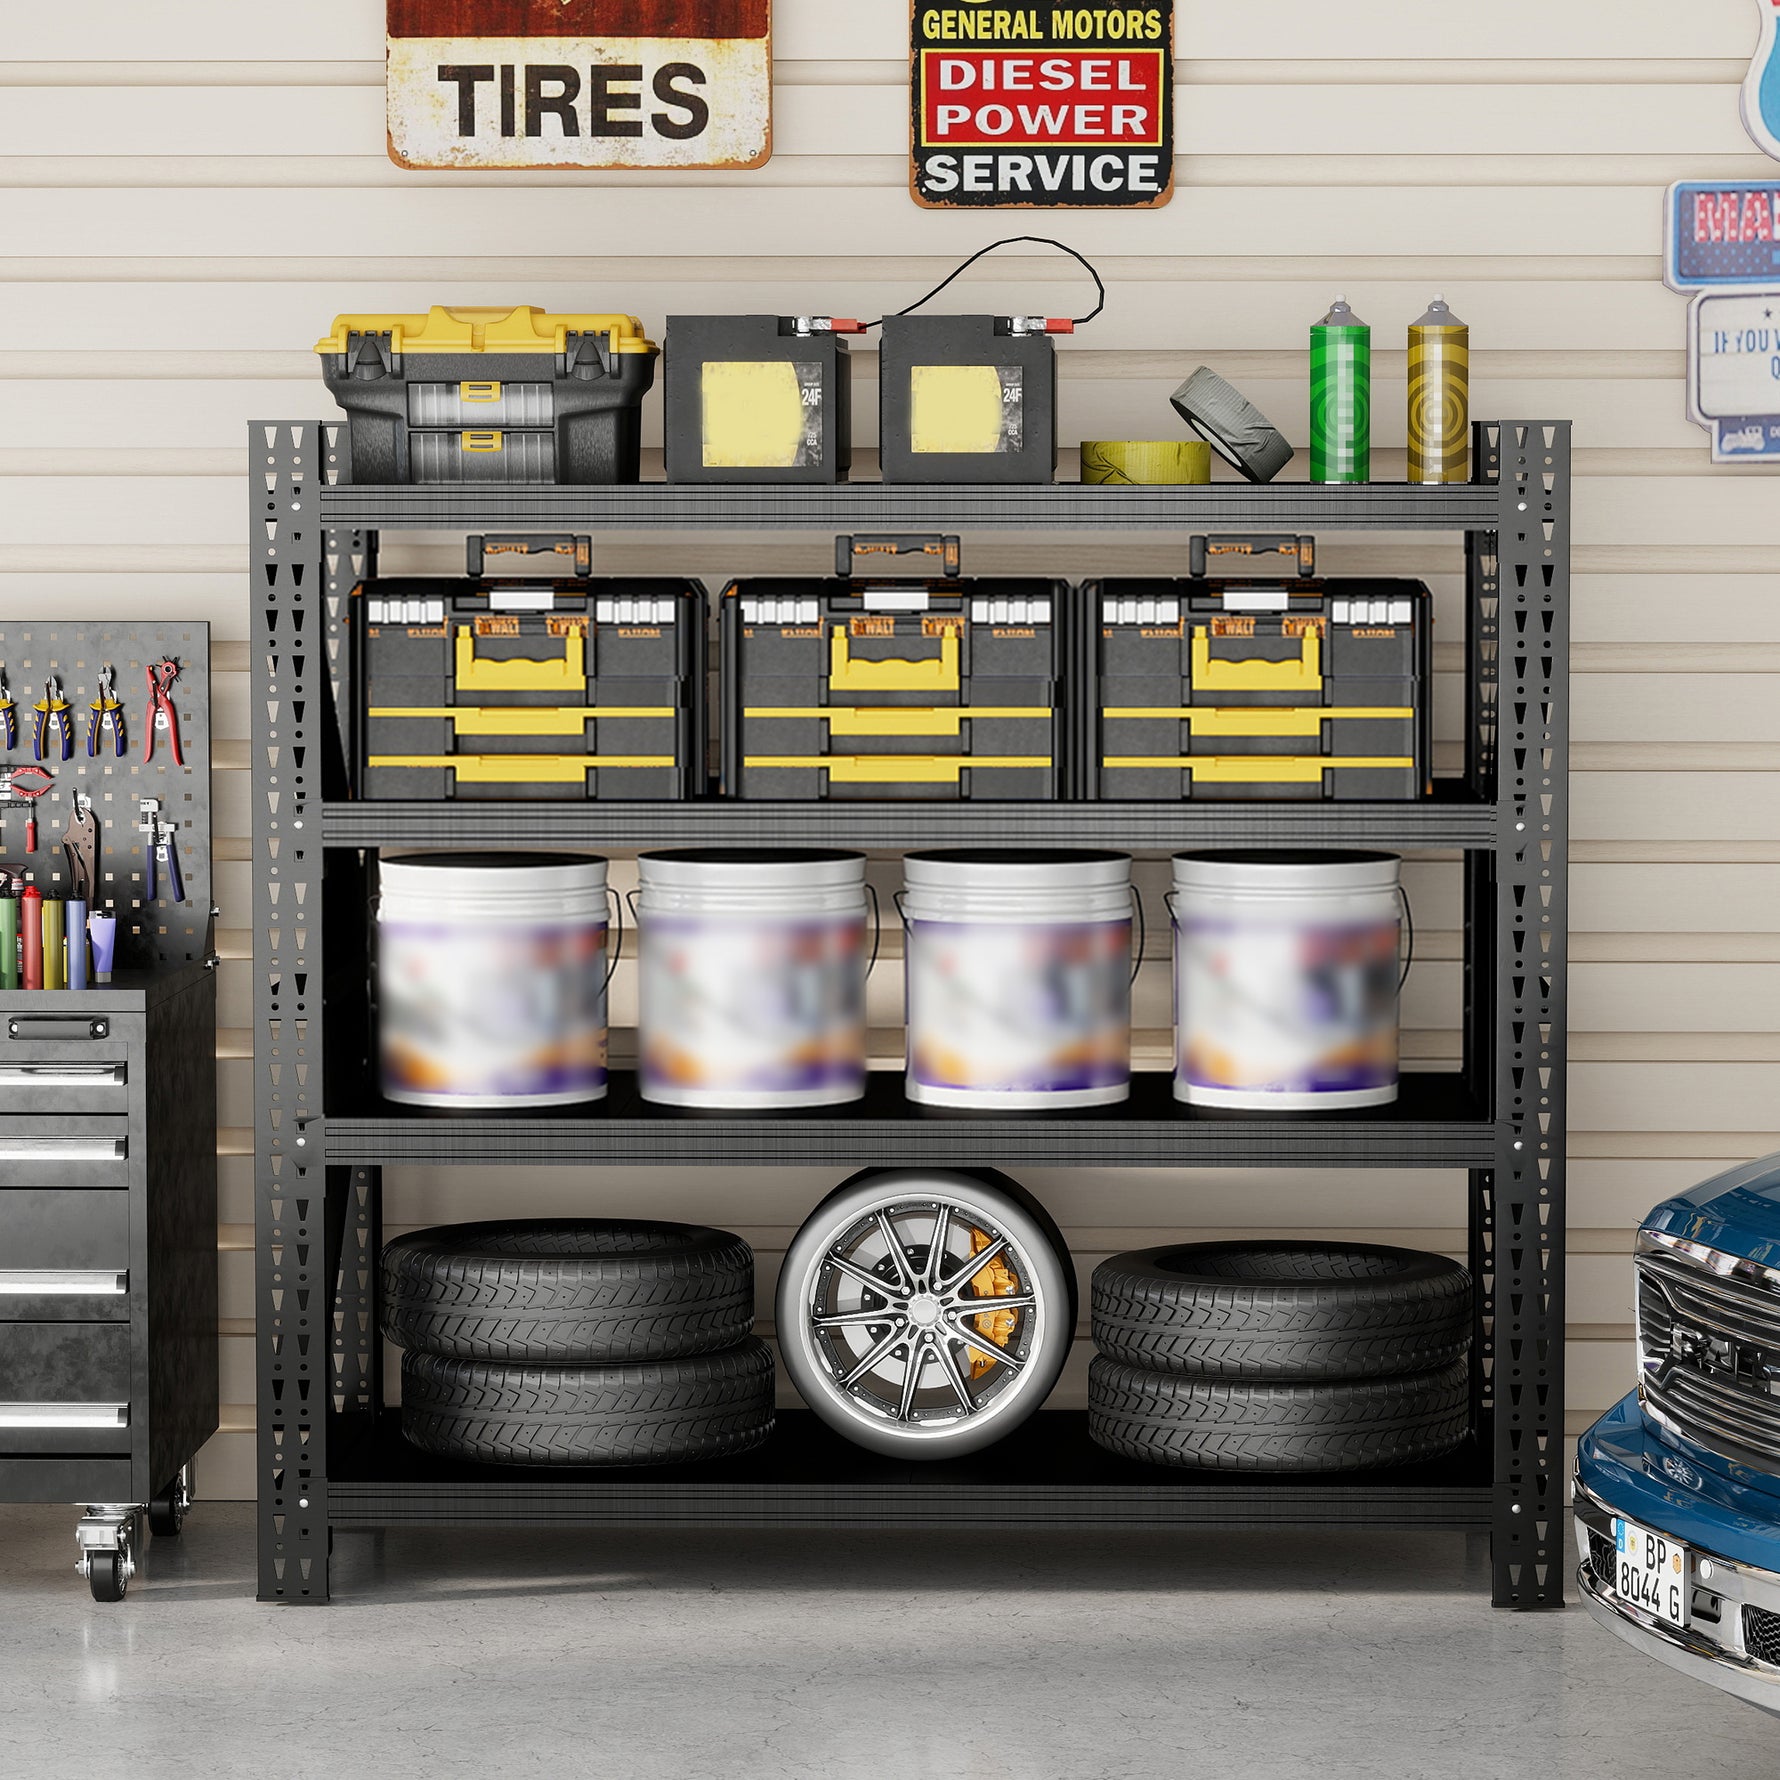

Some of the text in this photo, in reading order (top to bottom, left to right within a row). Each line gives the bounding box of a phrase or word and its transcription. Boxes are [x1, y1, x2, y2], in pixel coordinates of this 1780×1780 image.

[922, 9, 1162, 40] GENERAL MOTORS
[939, 59, 1147, 91] DIESEL
[438, 62, 709, 138] TIRES
[936, 103, 1149, 136] POWER
[924, 154, 1160, 192] SERVICE
[1736, 328, 1769, 354] YOU
[801, 387, 822, 406] 24F
[1003, 387, 1023, 403] 24F
[1646, 1533, 1667, 1574] BP
[1621, 1561, 1679, 1622] 8044 G
